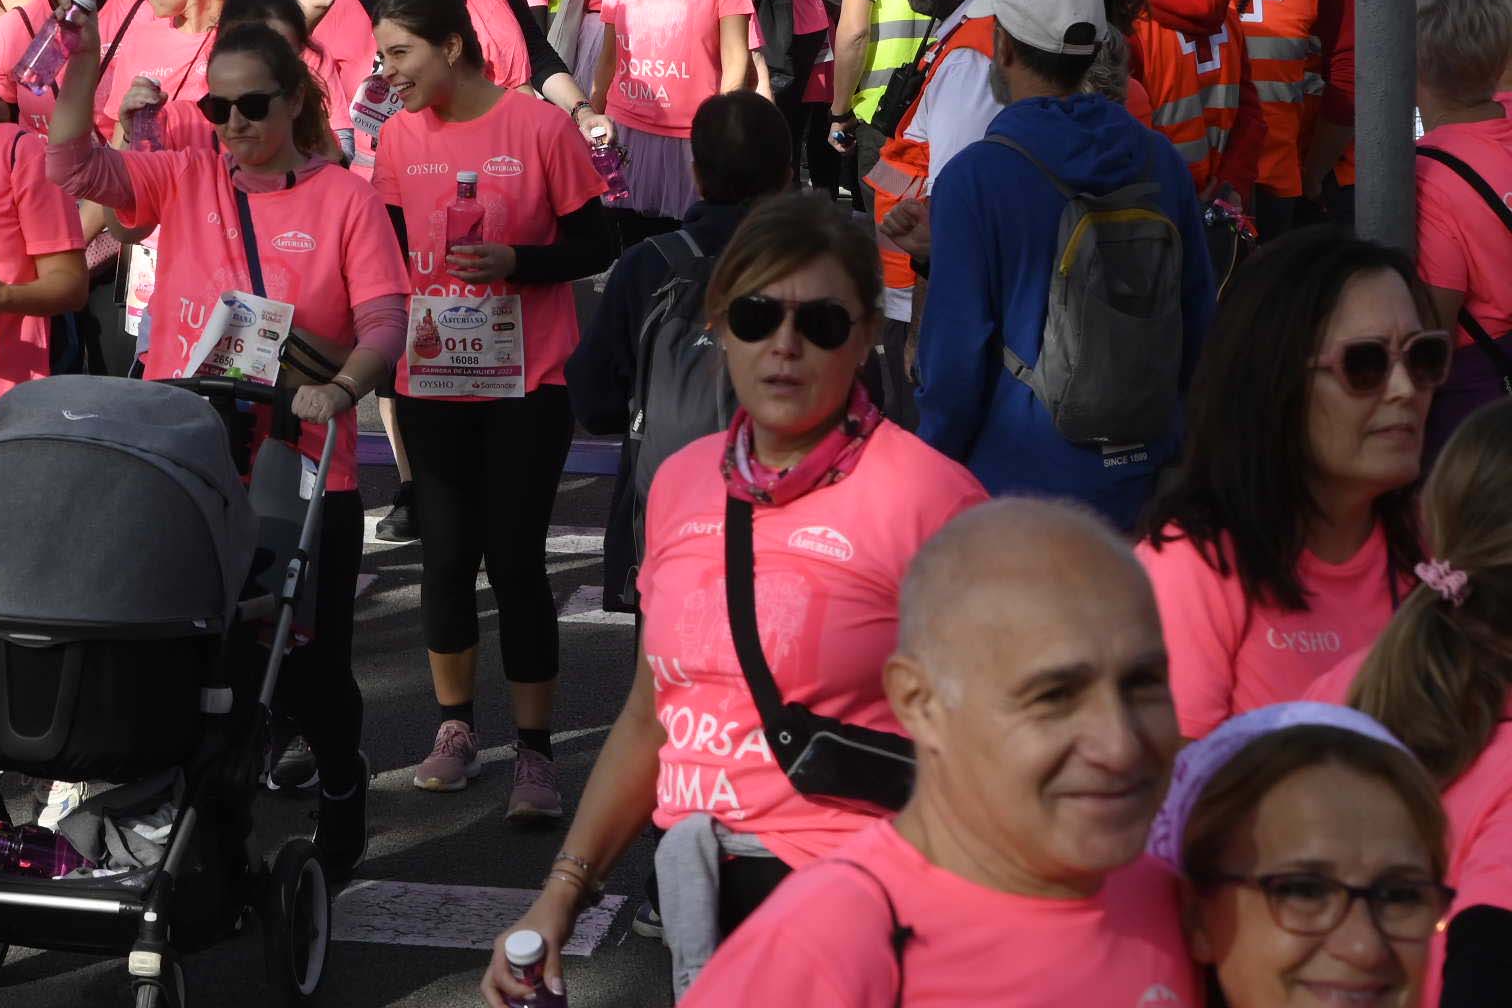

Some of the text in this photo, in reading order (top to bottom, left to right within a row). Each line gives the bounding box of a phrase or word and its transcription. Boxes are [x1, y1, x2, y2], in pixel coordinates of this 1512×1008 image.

[619, 59, 691, 79] DORSAL
[619, 81, 669, 102] SUMA
[407, 163, 449, 177] OYSHO
[180, 297, 206, 329] TU
[441, 314, 485, 324] ASTURIANA
[222, 335, 244, 354] 16
[444, 338, 484, 352] 016
[213, 354, 234, 367] 2650
[419, 380, 454, 389] OYSHO
[481, 380, 517, 390] Santander
[1103, 455, 1128, 468] SINCE
